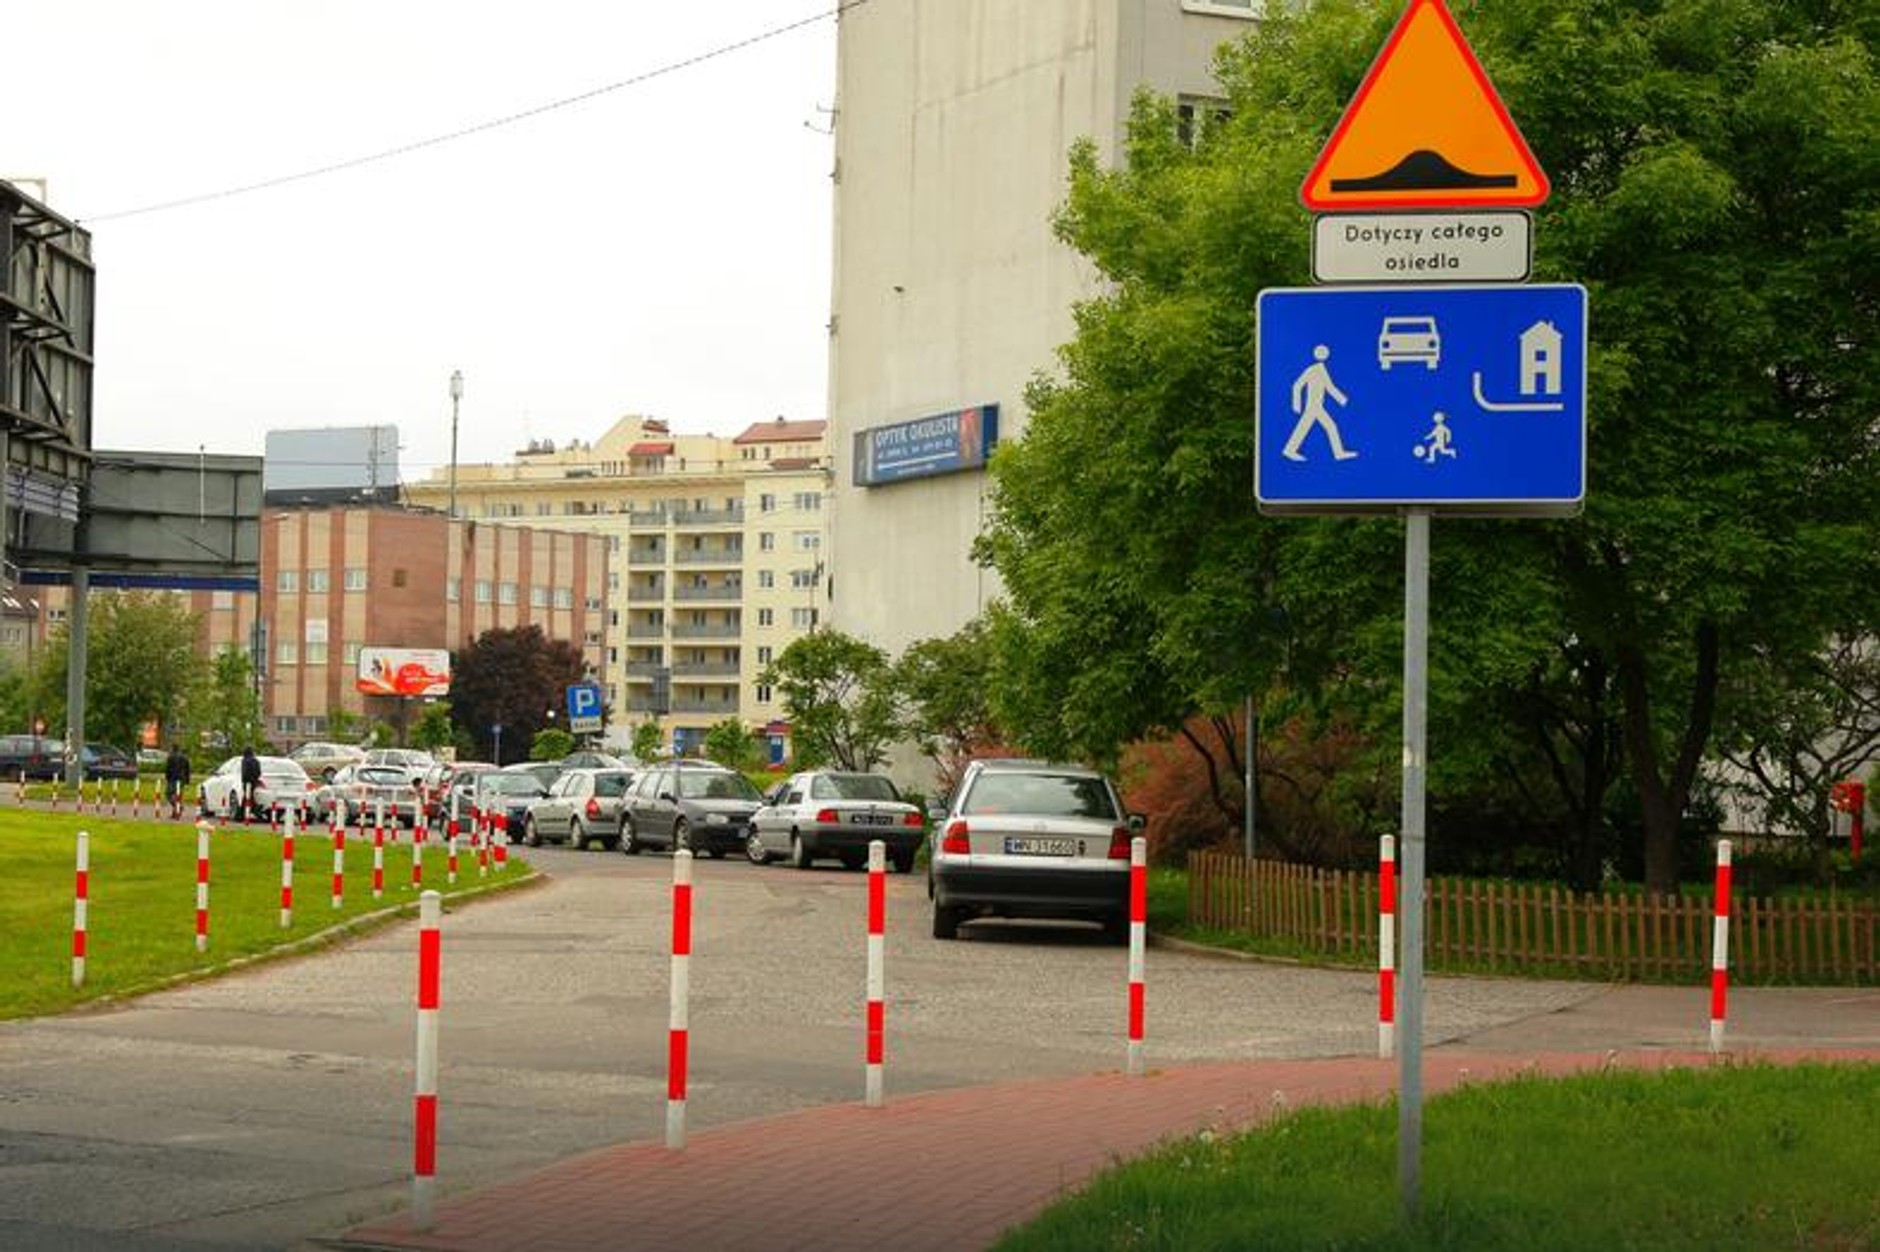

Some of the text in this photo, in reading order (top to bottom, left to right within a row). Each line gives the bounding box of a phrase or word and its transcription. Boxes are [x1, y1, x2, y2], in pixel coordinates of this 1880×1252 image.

[1344, 222, 1504, 244] Dotyczy całego
[1385, 253, 1460, 270] osiedla
[576, 689, 594, 714] P
